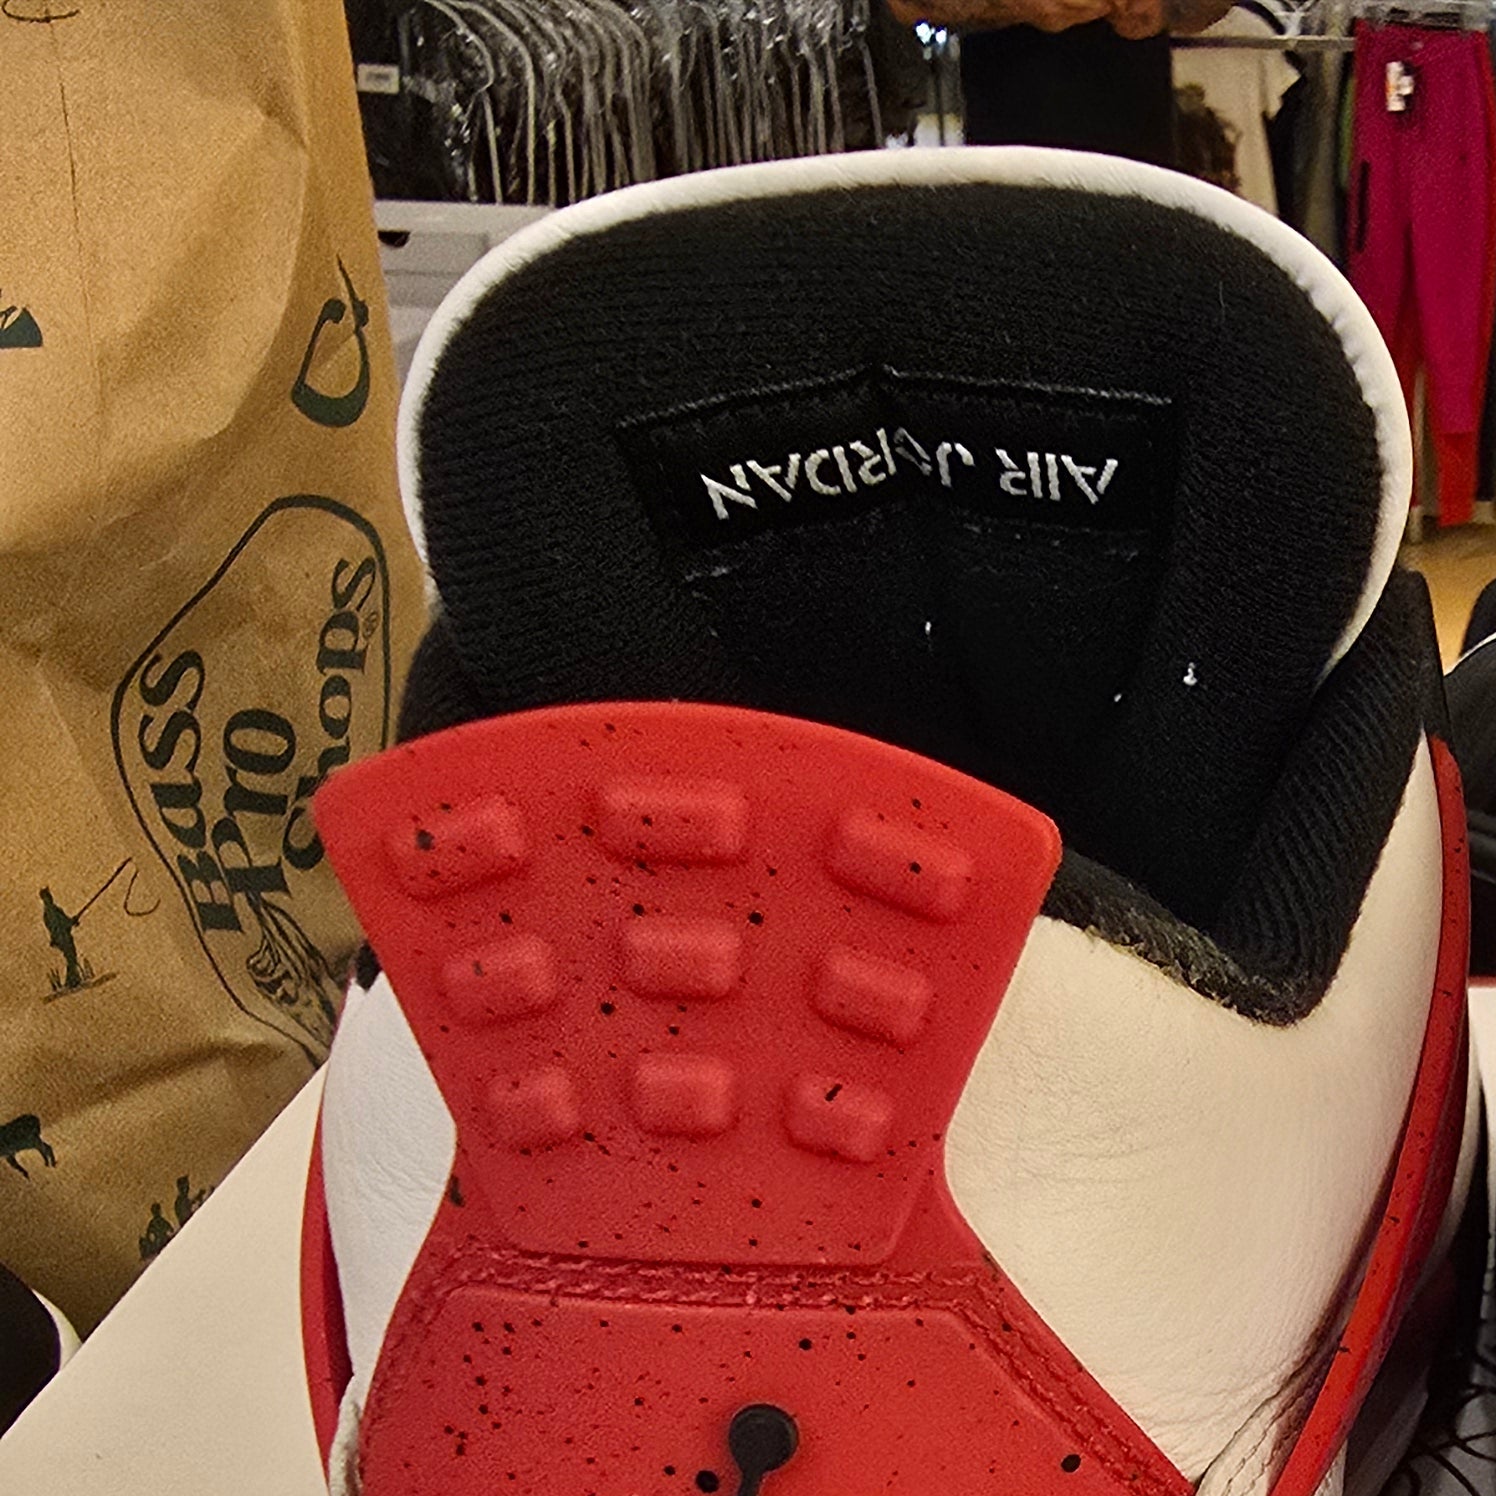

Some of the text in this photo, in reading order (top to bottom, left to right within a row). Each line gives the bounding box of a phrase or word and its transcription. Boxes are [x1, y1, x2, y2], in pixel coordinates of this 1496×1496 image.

[995, 447, 1119, 504] AIR
[136, 649, 244, 935] Bass
[209, 708, 297, 897] Pro
